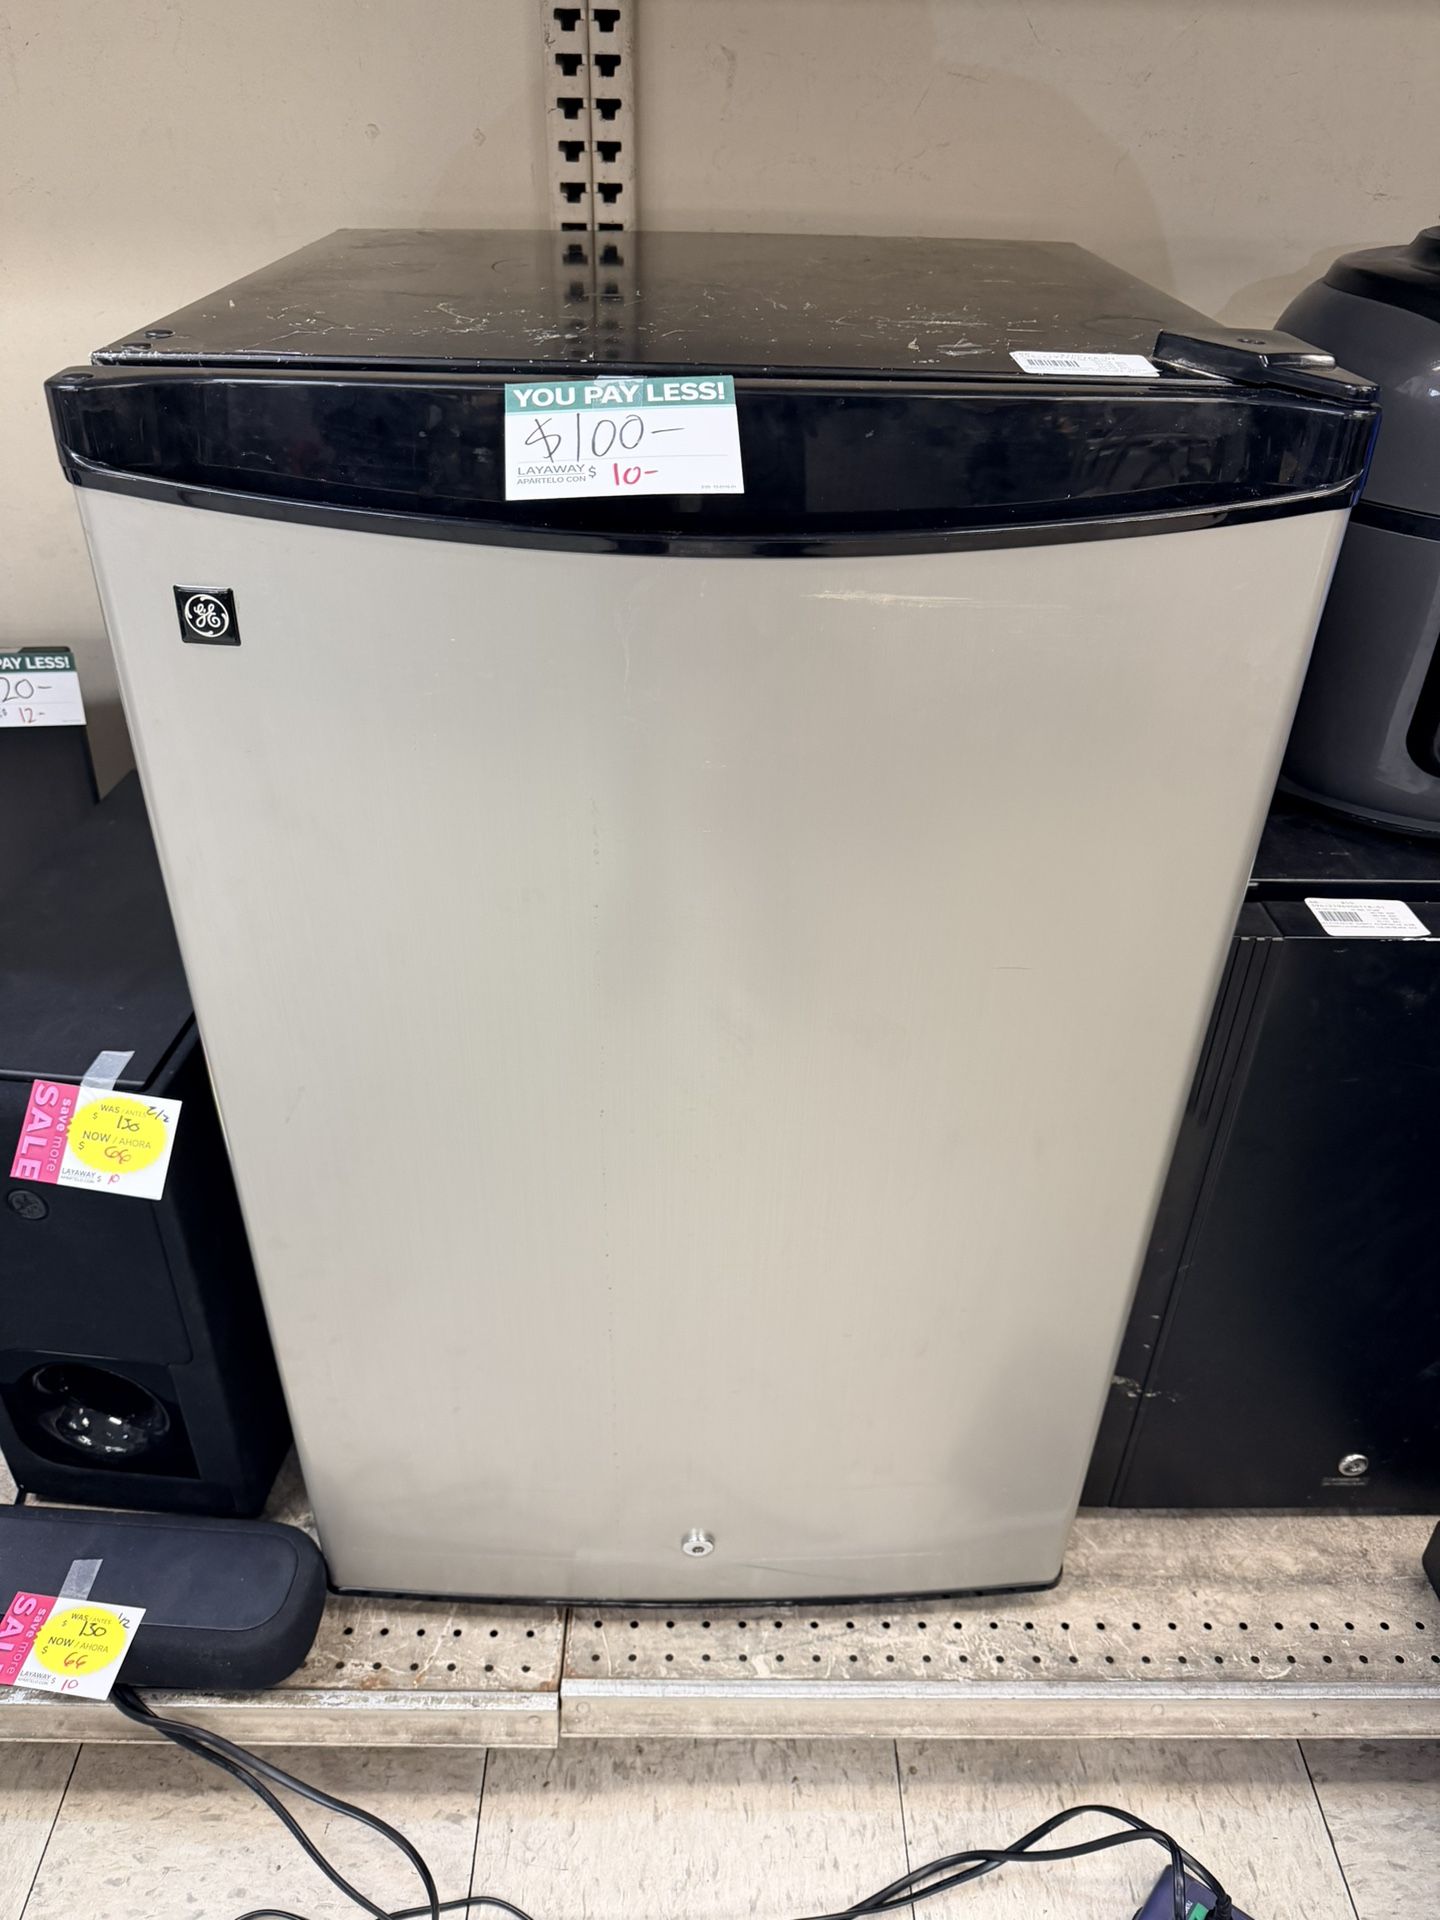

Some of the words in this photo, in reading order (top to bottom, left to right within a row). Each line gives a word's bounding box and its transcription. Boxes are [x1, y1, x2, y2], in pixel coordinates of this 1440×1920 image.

[513, 387, 576, 408] YOU
[584, 384, 641, 405] PAY
[646, 381, 726, 402] LESS!
[517, 463, 586, 476] LAYAWAY
[588, 465, 597, 478] $
[565, 475, 586, 483] CON
[0, 656, 22, 670] AY
[25, 656, 71, 670] LESS!
[55, 1098, 72, 1132] save
[101, 1104, 120, 1114] WAS
[16, 1083, 60, 1181] SALE
[82, 1130, 111, 1143] NOW
[118, 1137, 151, 1149] AHORA
[78, 1141, 85, 1151] $
[46, 1136, 64, 1173] more
[61, 1168, 96, 1178] LAYAWAY
[25, 1607, 47, 1638] save
[71, 1613, 88, 1622] WAS
[41, 1645, 49, 1654] $
[48, 1636, 75, 1647] NOW
[80, 1641, 109, 1653] AHORA
[6, 1642, 28, 1674] more
[19, 1670, 51, 1680] LAYAWAY
